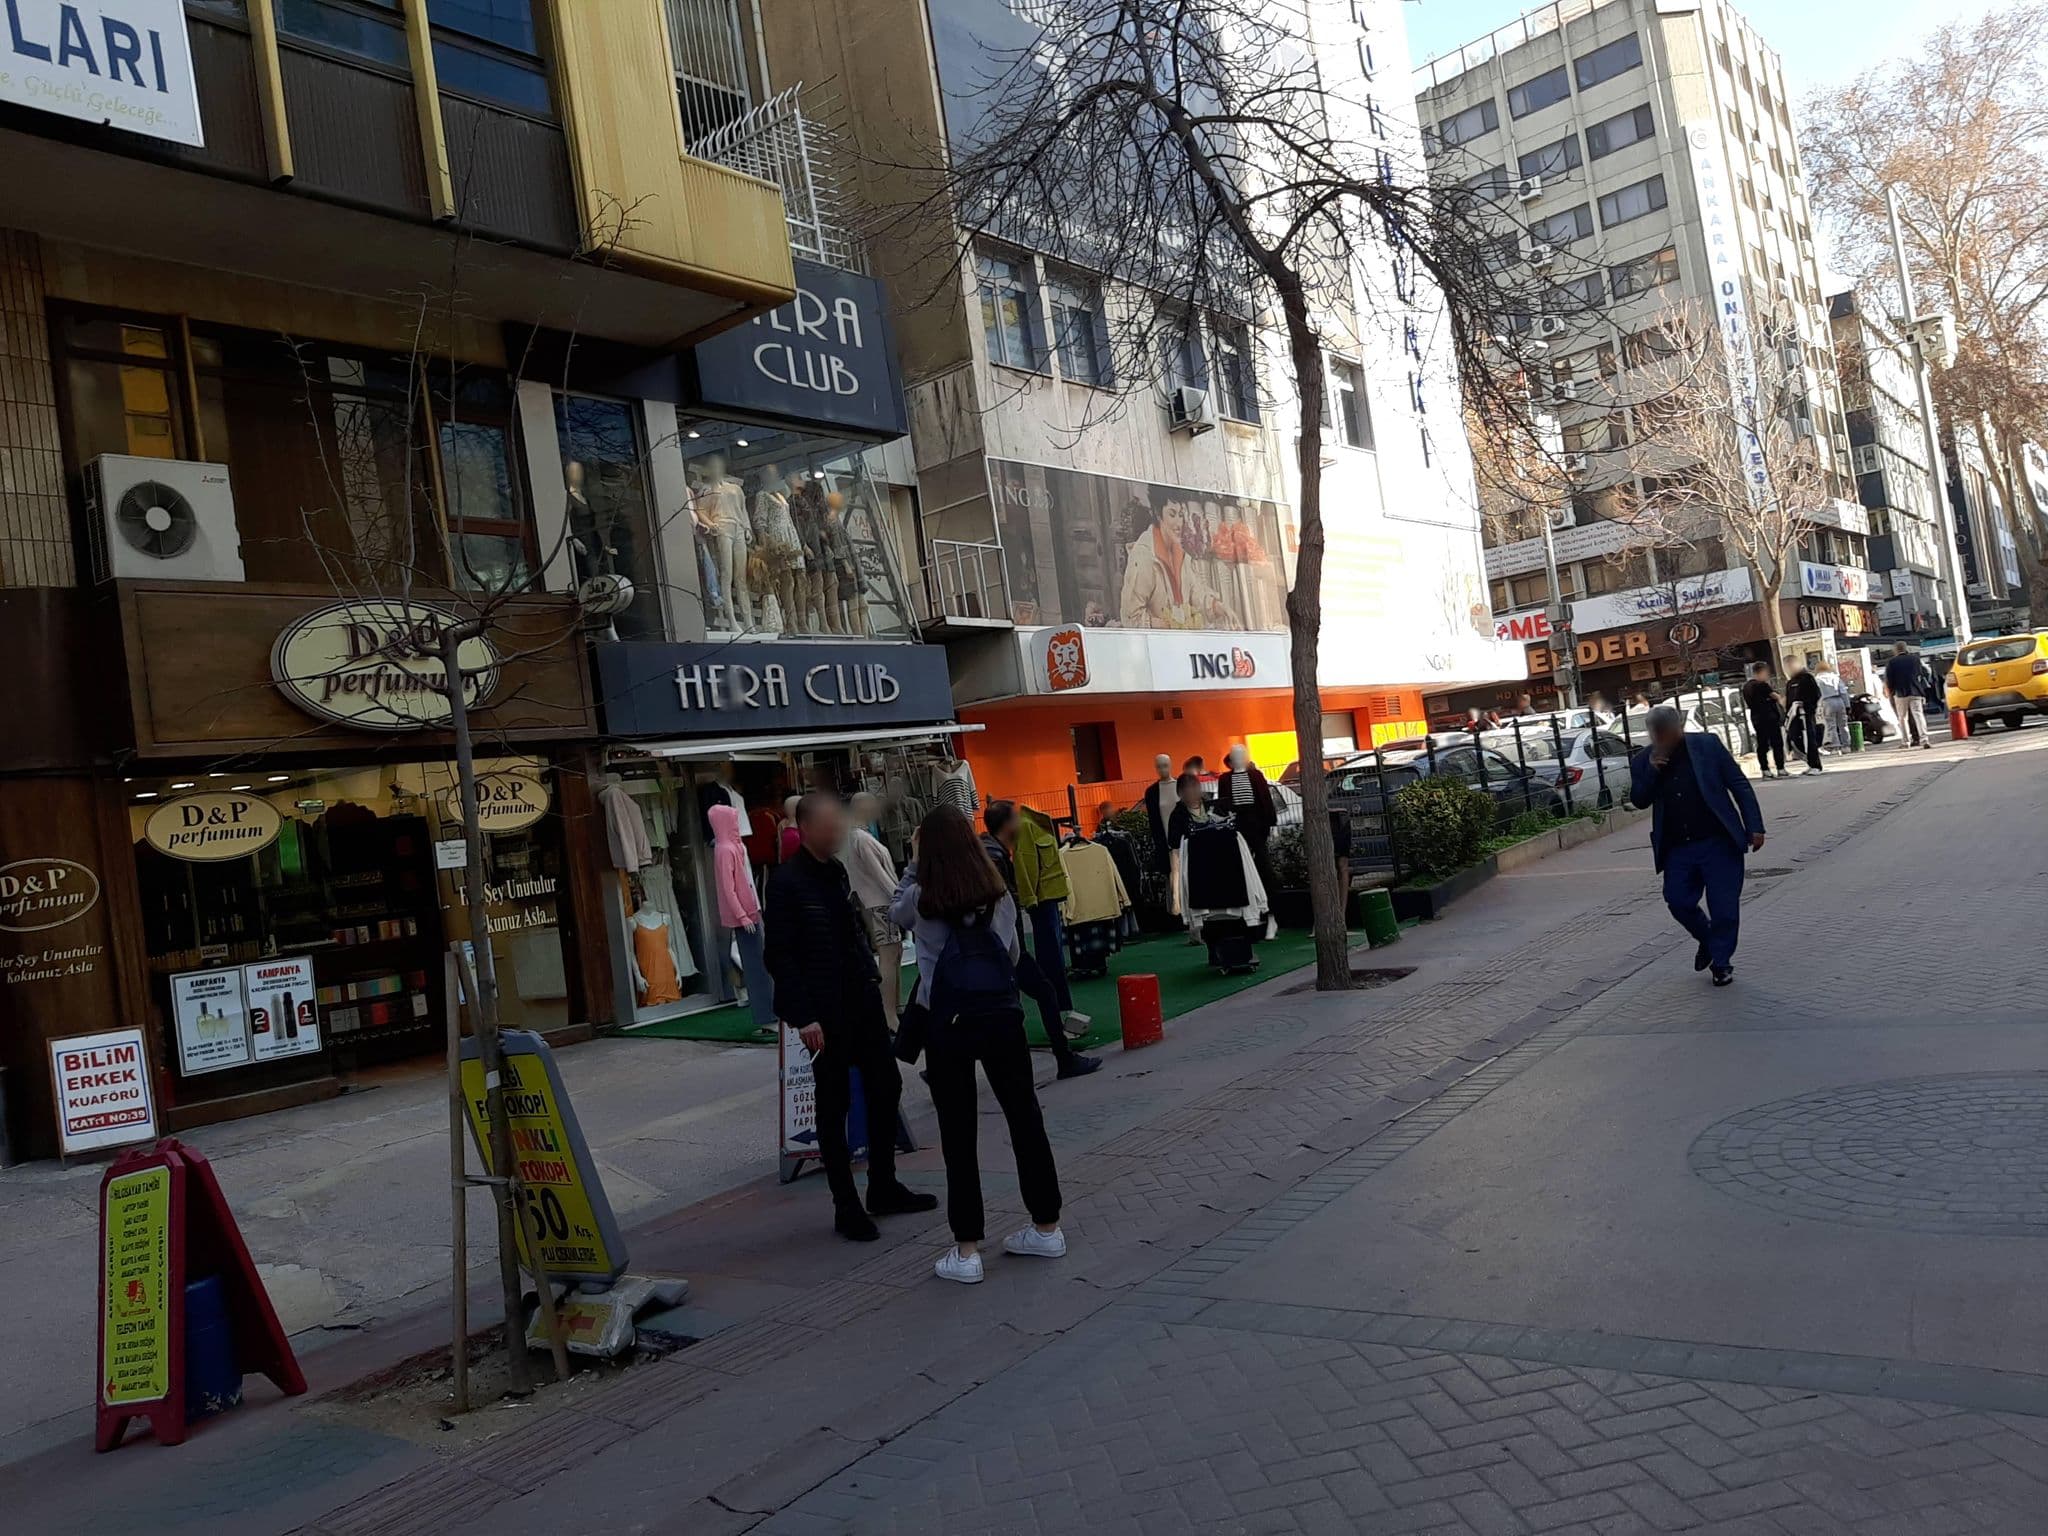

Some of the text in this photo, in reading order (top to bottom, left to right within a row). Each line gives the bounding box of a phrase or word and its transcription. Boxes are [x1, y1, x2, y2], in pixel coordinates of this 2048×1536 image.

[1700, 157, 1729, 265] ANKARA
[753, 343, 859, 395] CLUB
[998, 484, 1031, 507] ING
[1637, 595, 1674, 609] Kızıla
[1510, 612, 1553, 640] ME
[1189, 652, 1229, 680] ING
[674, 663, 901, 710] HERA CLUB
[180, 800, 248, 826] D&P
[478, 802, 535, 820] rfumum
[168, 826, 263, 849] perfumum
[0, 868, 66, 898] D&P
[484, 882, 505, 906] Şey
[507, 875, 556, 900] Unutulur
[486, 913, 521, 934] kunuz
[42, 944, 104, 962] Unutulur
[6, 960, 94, 985] Kokunuz Asla
[257, 965, 301, 979] KAMPANYA
[254, 1011, 266, 1025] 2
[301, 1004, 312, 1017] 1
[67, 1068, 136, 1091] ERKEK
[69, 1088, 139, 1108] KUAFÖRÜ
[475, 1090, 548, 1119] FOKOPİ
[793, 1090, 816, 1103] GÖZL
[109, 1110, 146, 1123] NO:39
